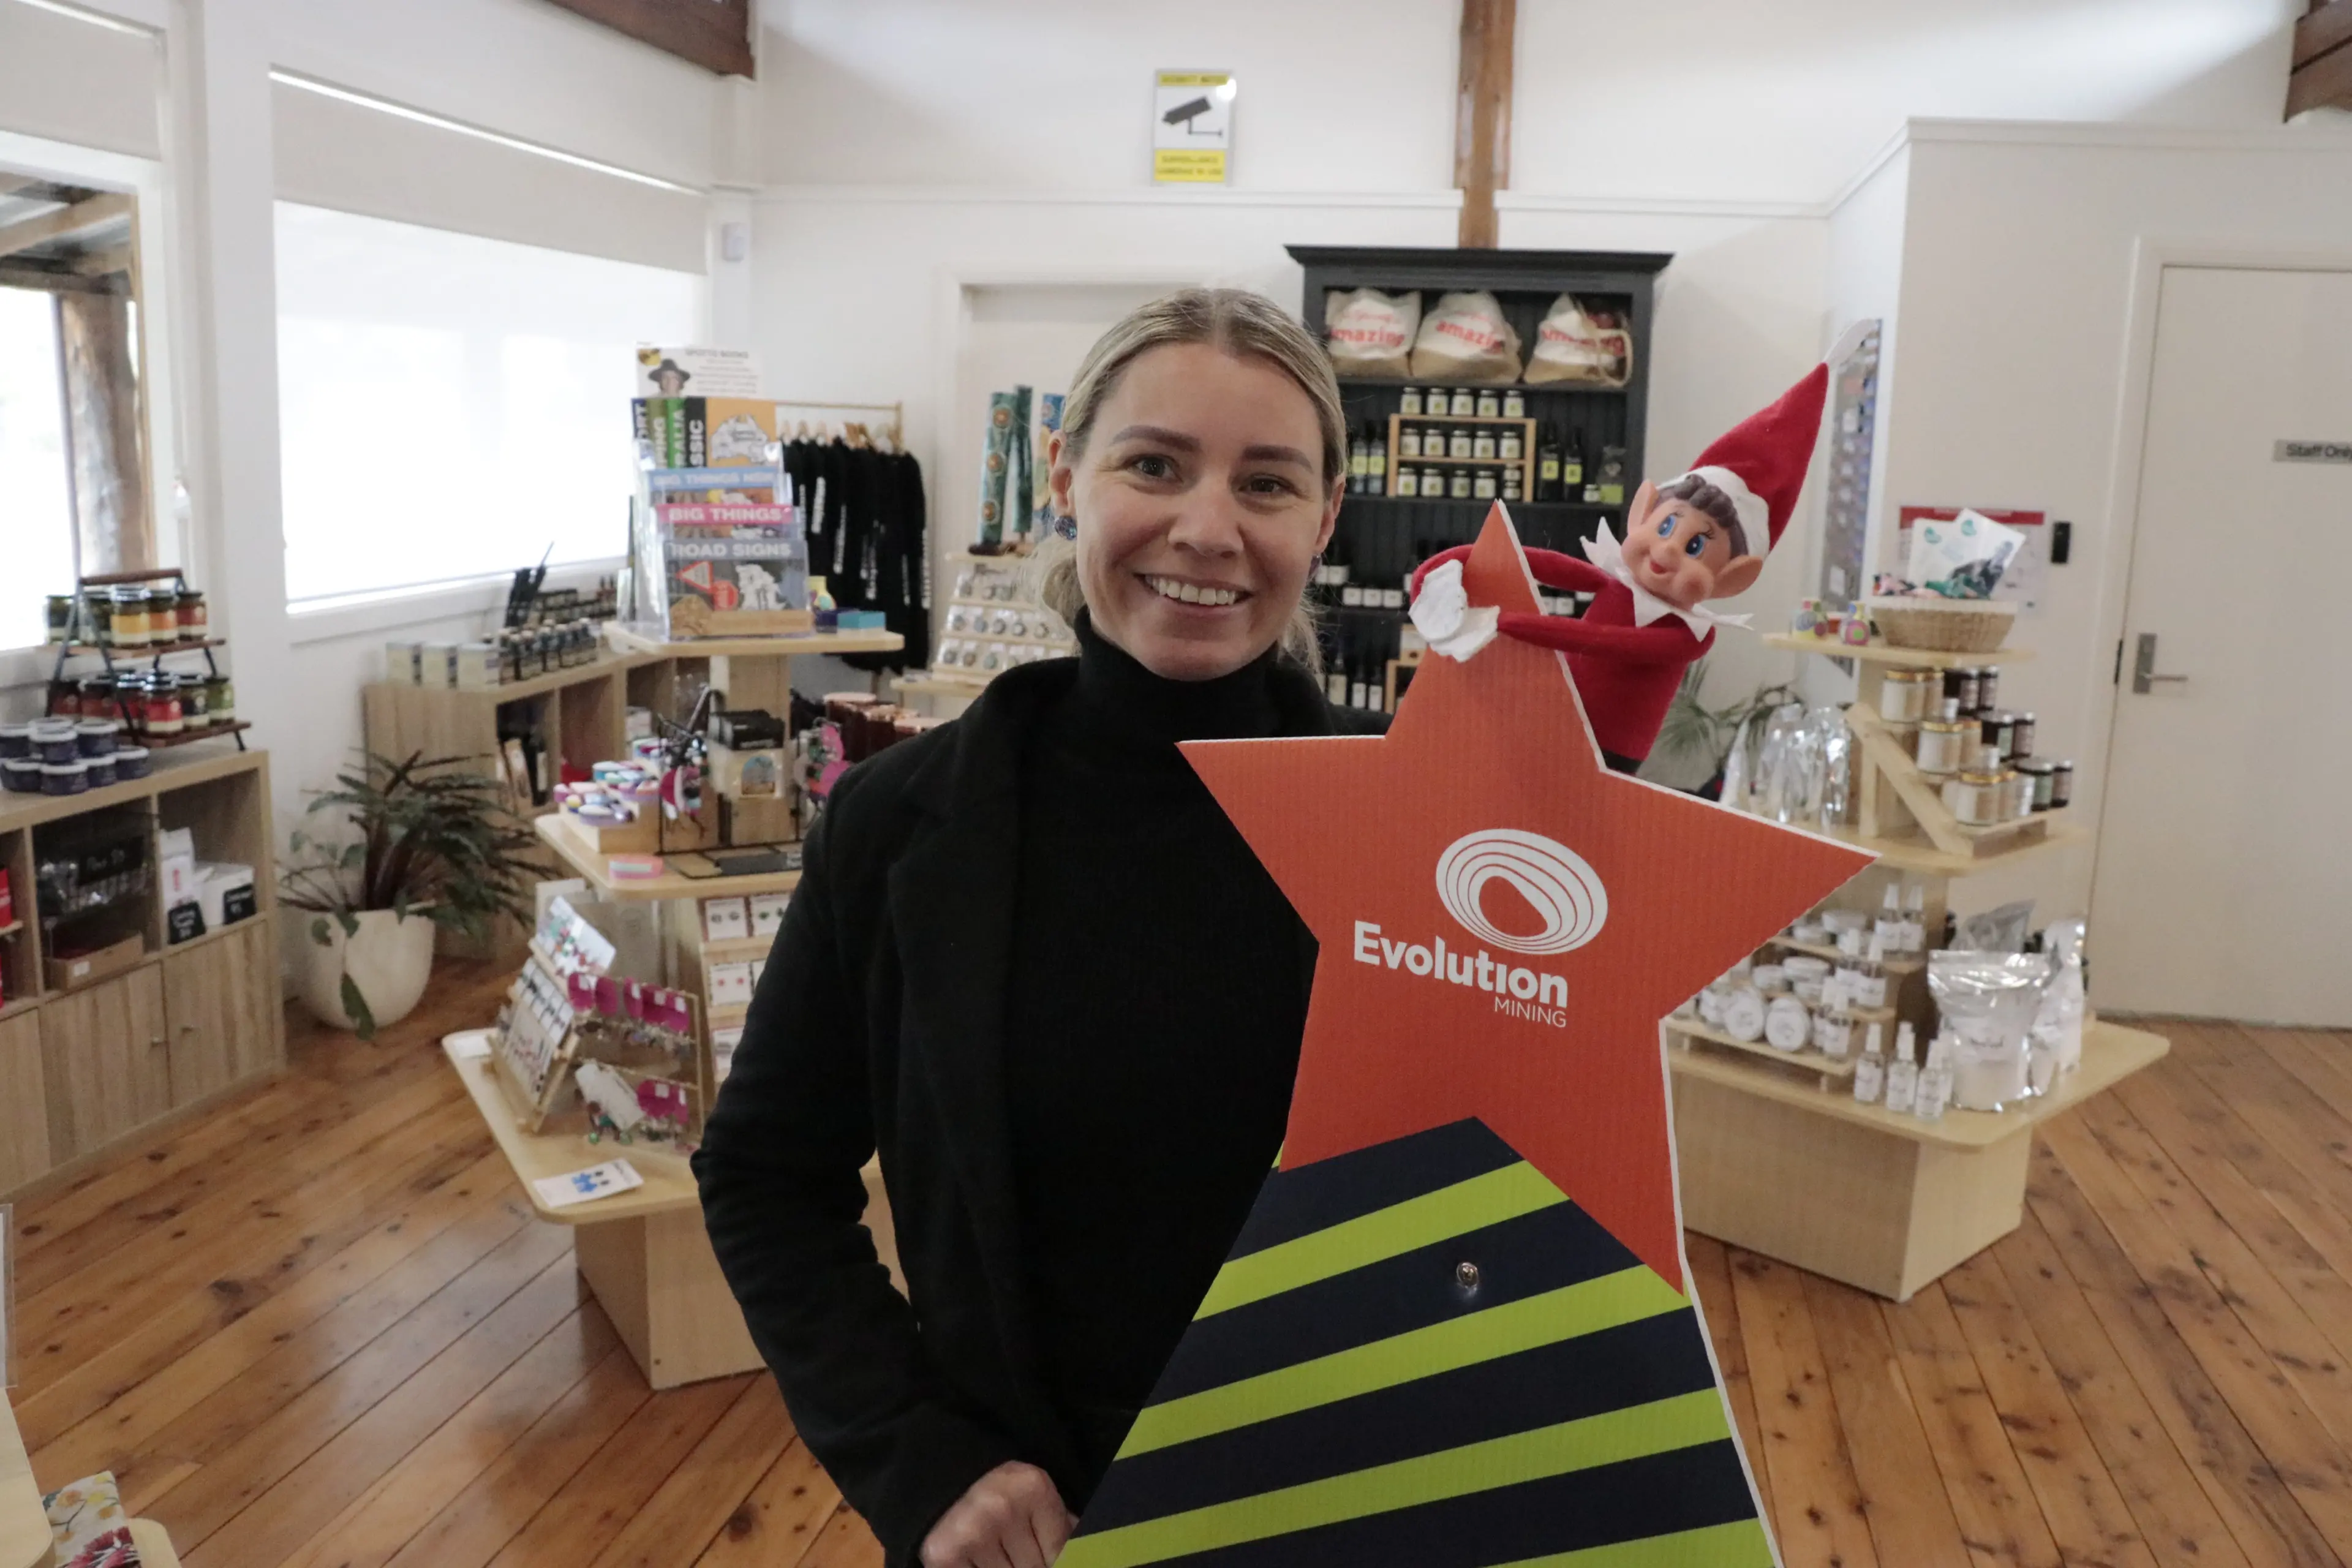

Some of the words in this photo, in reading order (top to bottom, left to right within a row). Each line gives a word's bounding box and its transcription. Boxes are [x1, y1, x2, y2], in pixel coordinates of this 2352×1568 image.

[689, 419, 704, 467] SSIC
[669, 507, 704, 521] BIG
[709, 508, 782, 521] THINGS
[732, 543, 792, 557] SIGNS
[1354, 919, 1569, 1008] Evolution
[1494, 996, 1567, 1028] MINING
